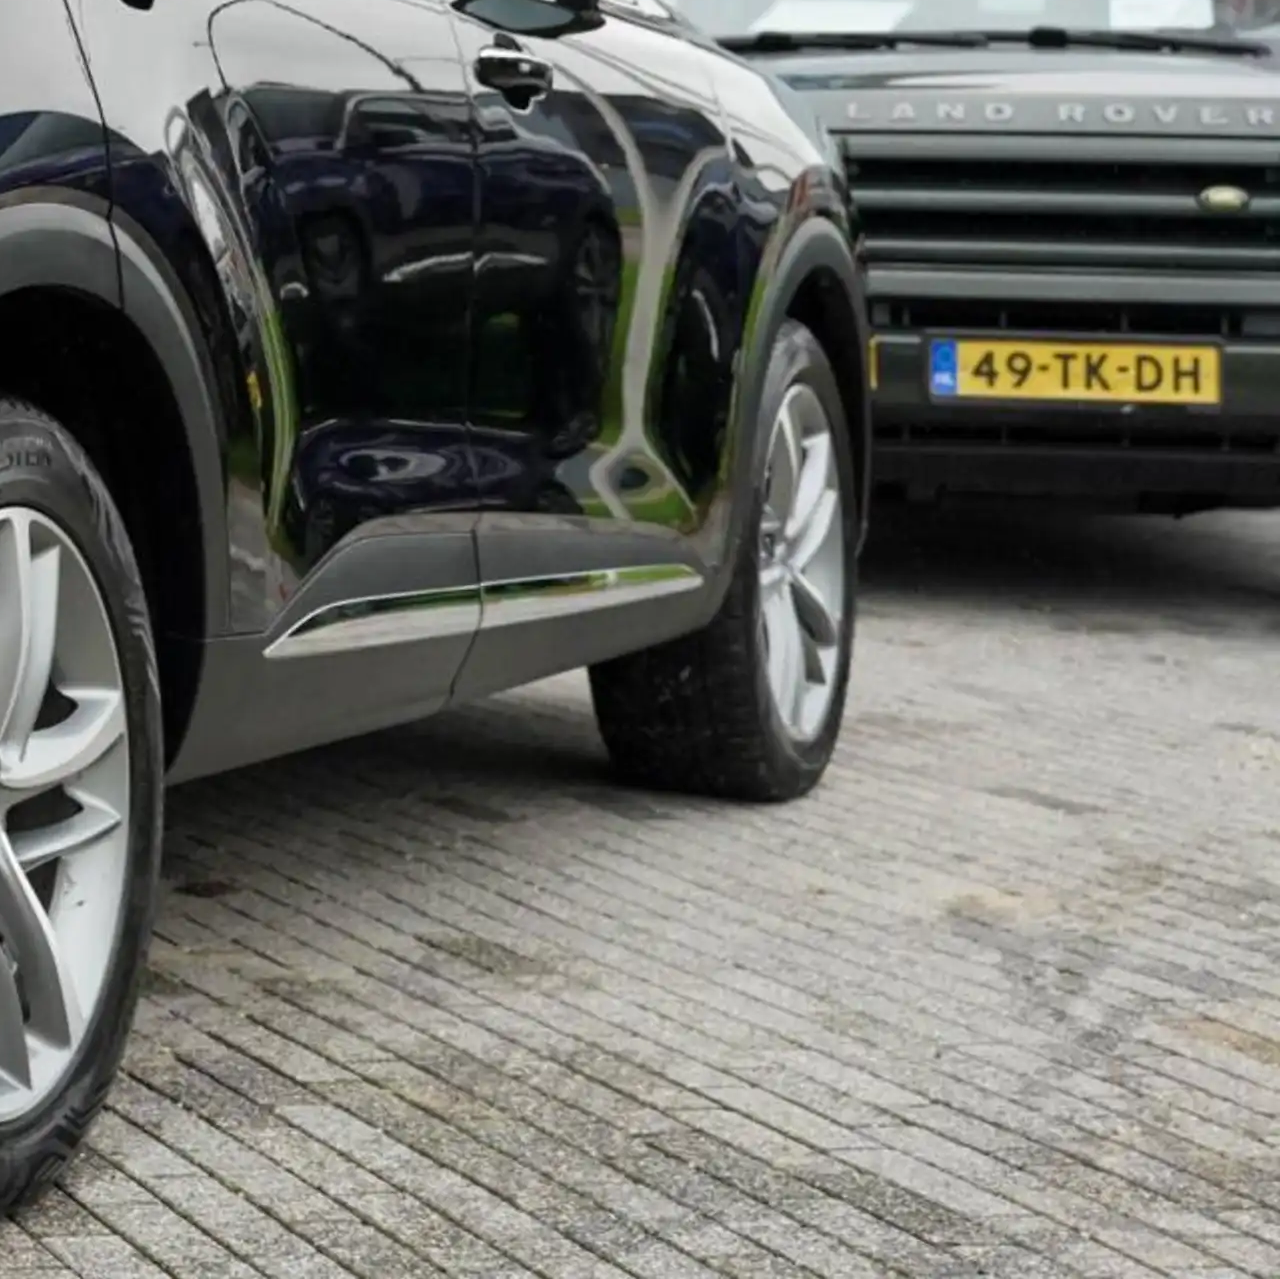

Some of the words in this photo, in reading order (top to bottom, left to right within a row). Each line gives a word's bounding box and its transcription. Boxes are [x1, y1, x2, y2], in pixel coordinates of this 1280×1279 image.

[847, 102, 1014, 120] LAND
[1058, 103, 1277, 125] ROVER
[971, 351, 1202, 394] 49-TK-DH
